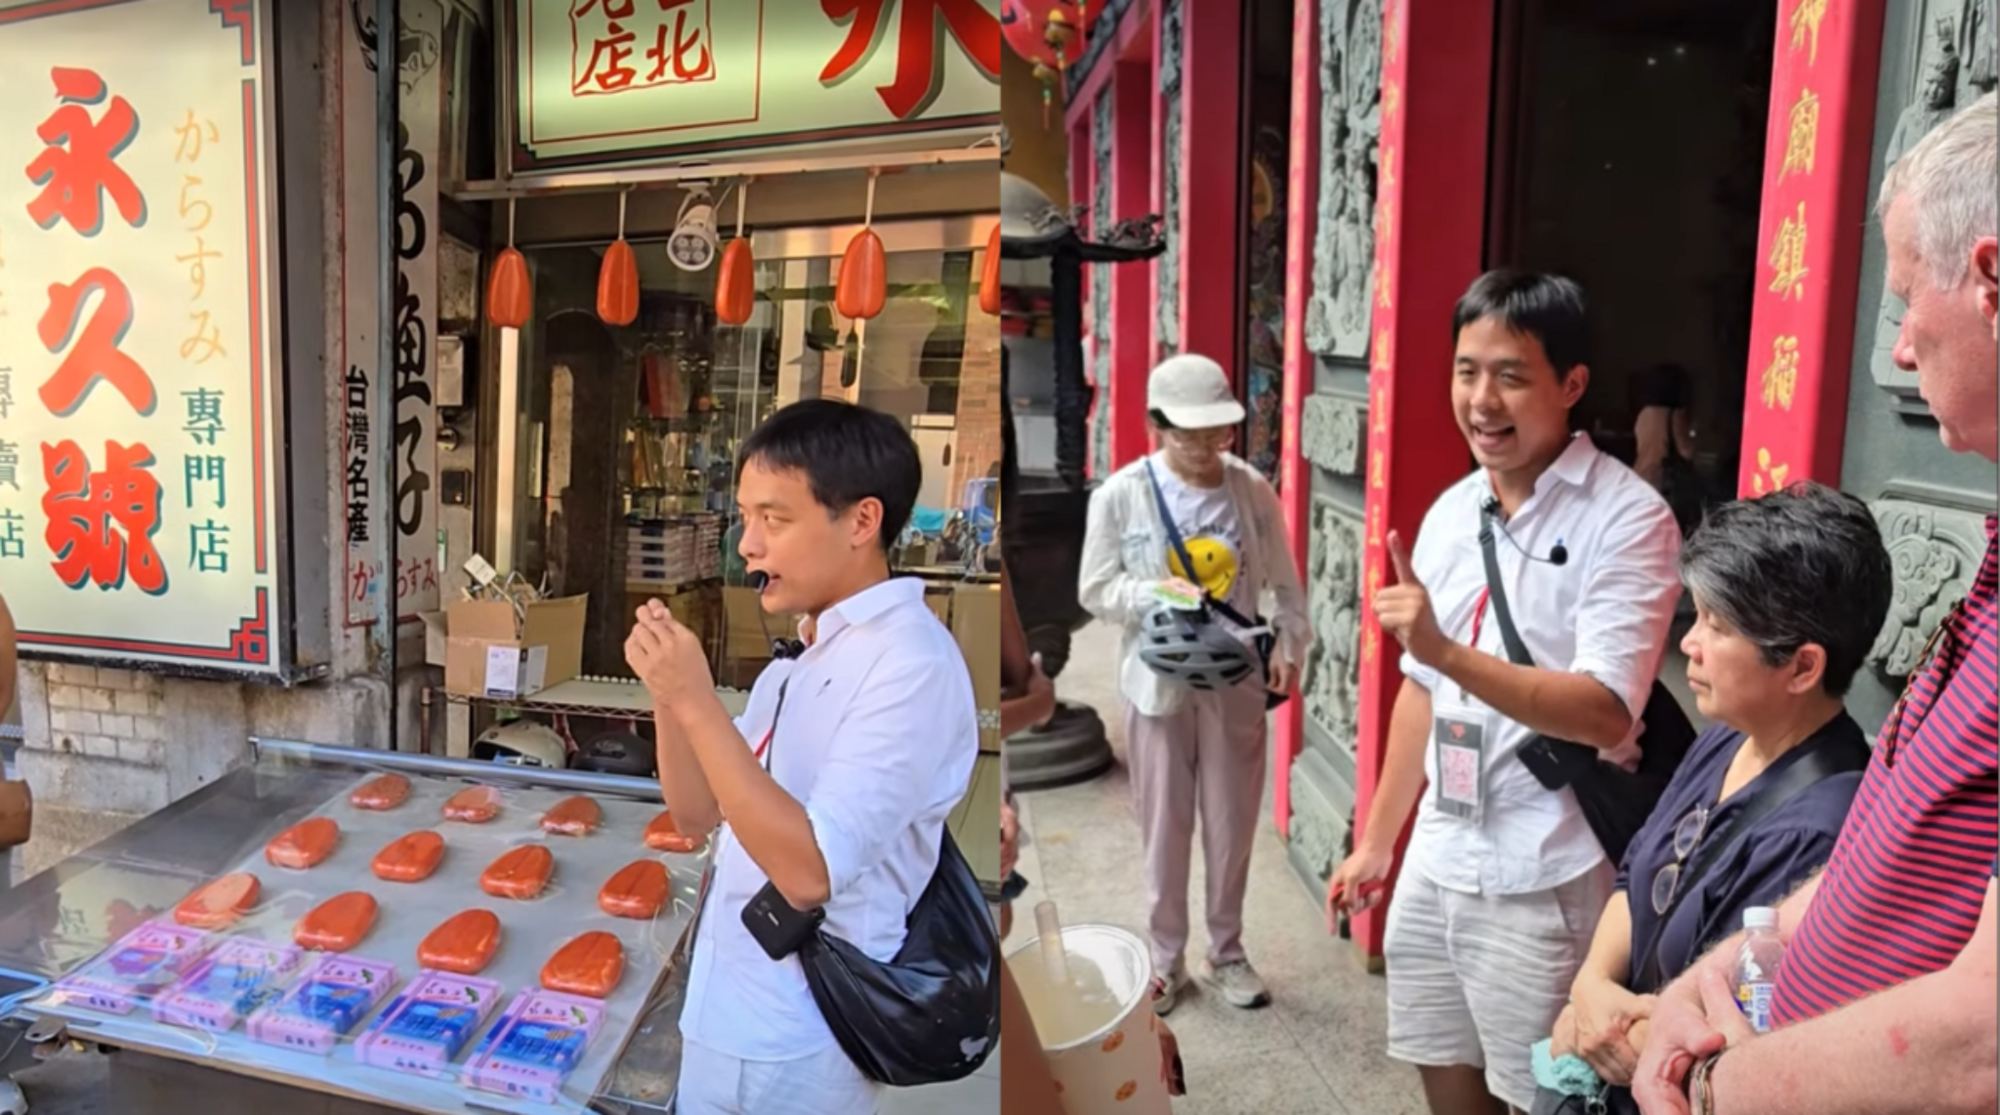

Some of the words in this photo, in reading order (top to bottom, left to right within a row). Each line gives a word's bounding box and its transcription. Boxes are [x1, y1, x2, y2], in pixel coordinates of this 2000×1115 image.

[25, 66, 168, 595] 永久號
[346, 364, 369, 543] 台灣名產
